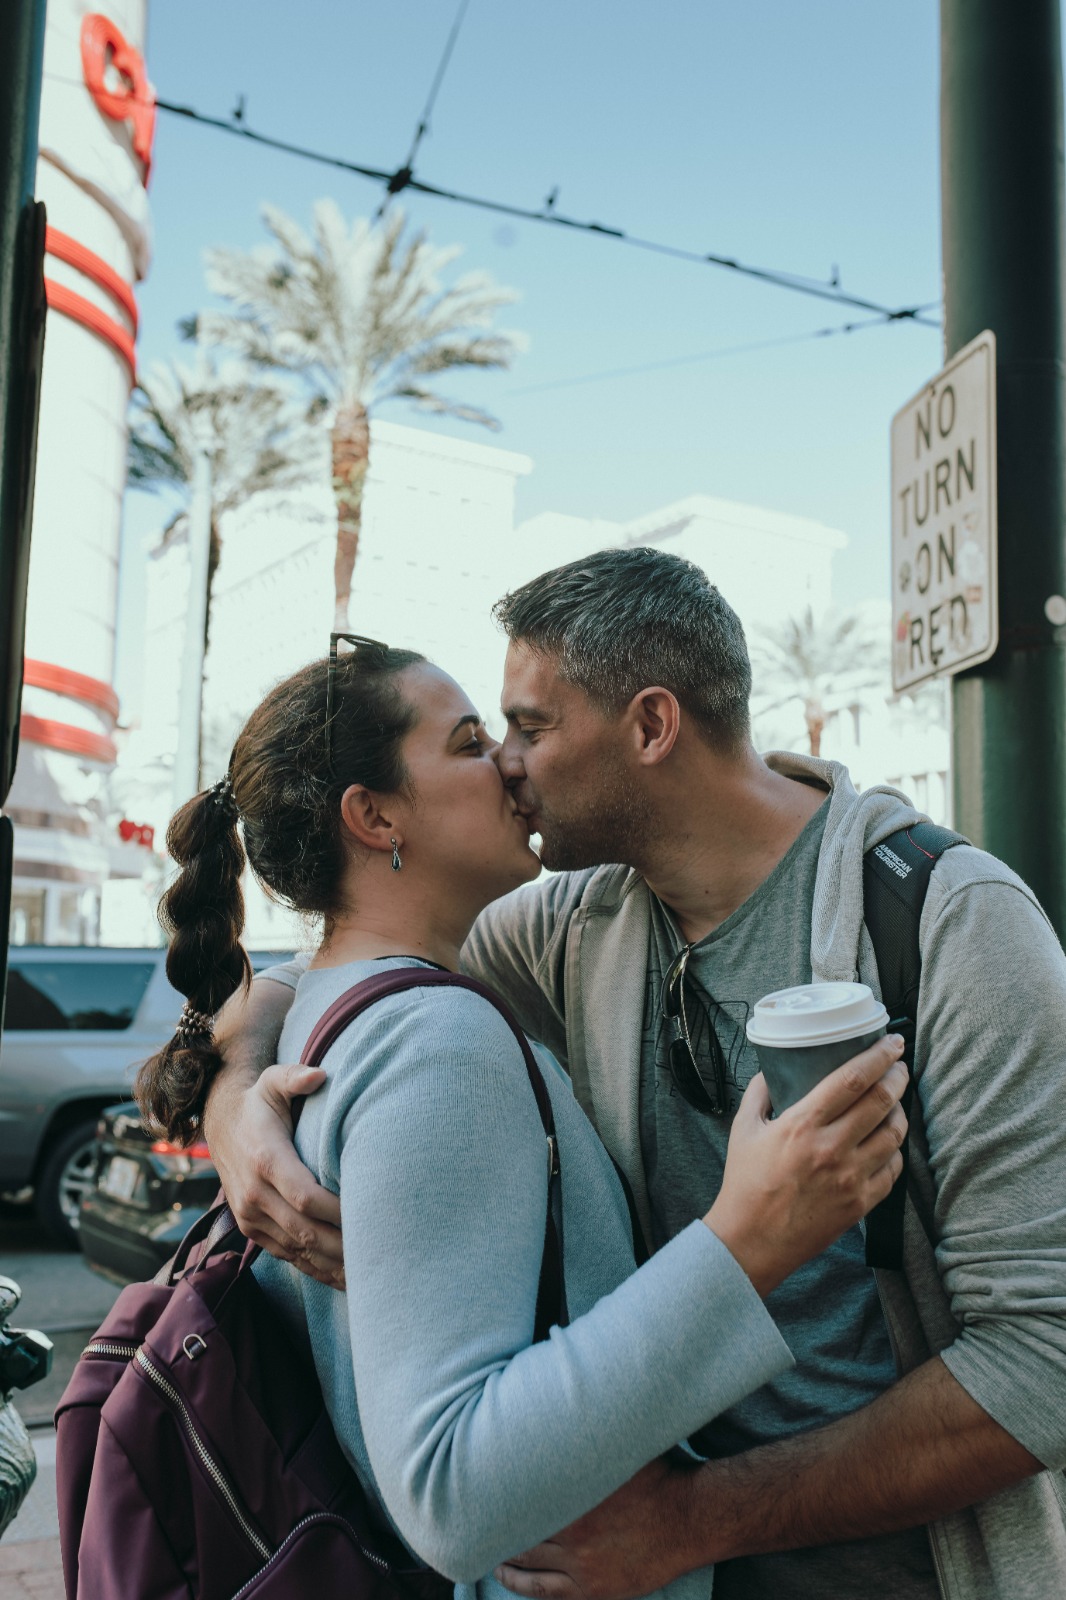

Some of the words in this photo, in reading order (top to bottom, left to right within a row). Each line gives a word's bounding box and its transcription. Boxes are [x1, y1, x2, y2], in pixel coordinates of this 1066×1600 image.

[915, 385, 956, 458] NO
[900, 438, 975, 537] TURN
[915, 525, 955, 595] ON
[873, 847, 908, 878] TOURISTER
[878, 844, 913, 873] AMERICAN
